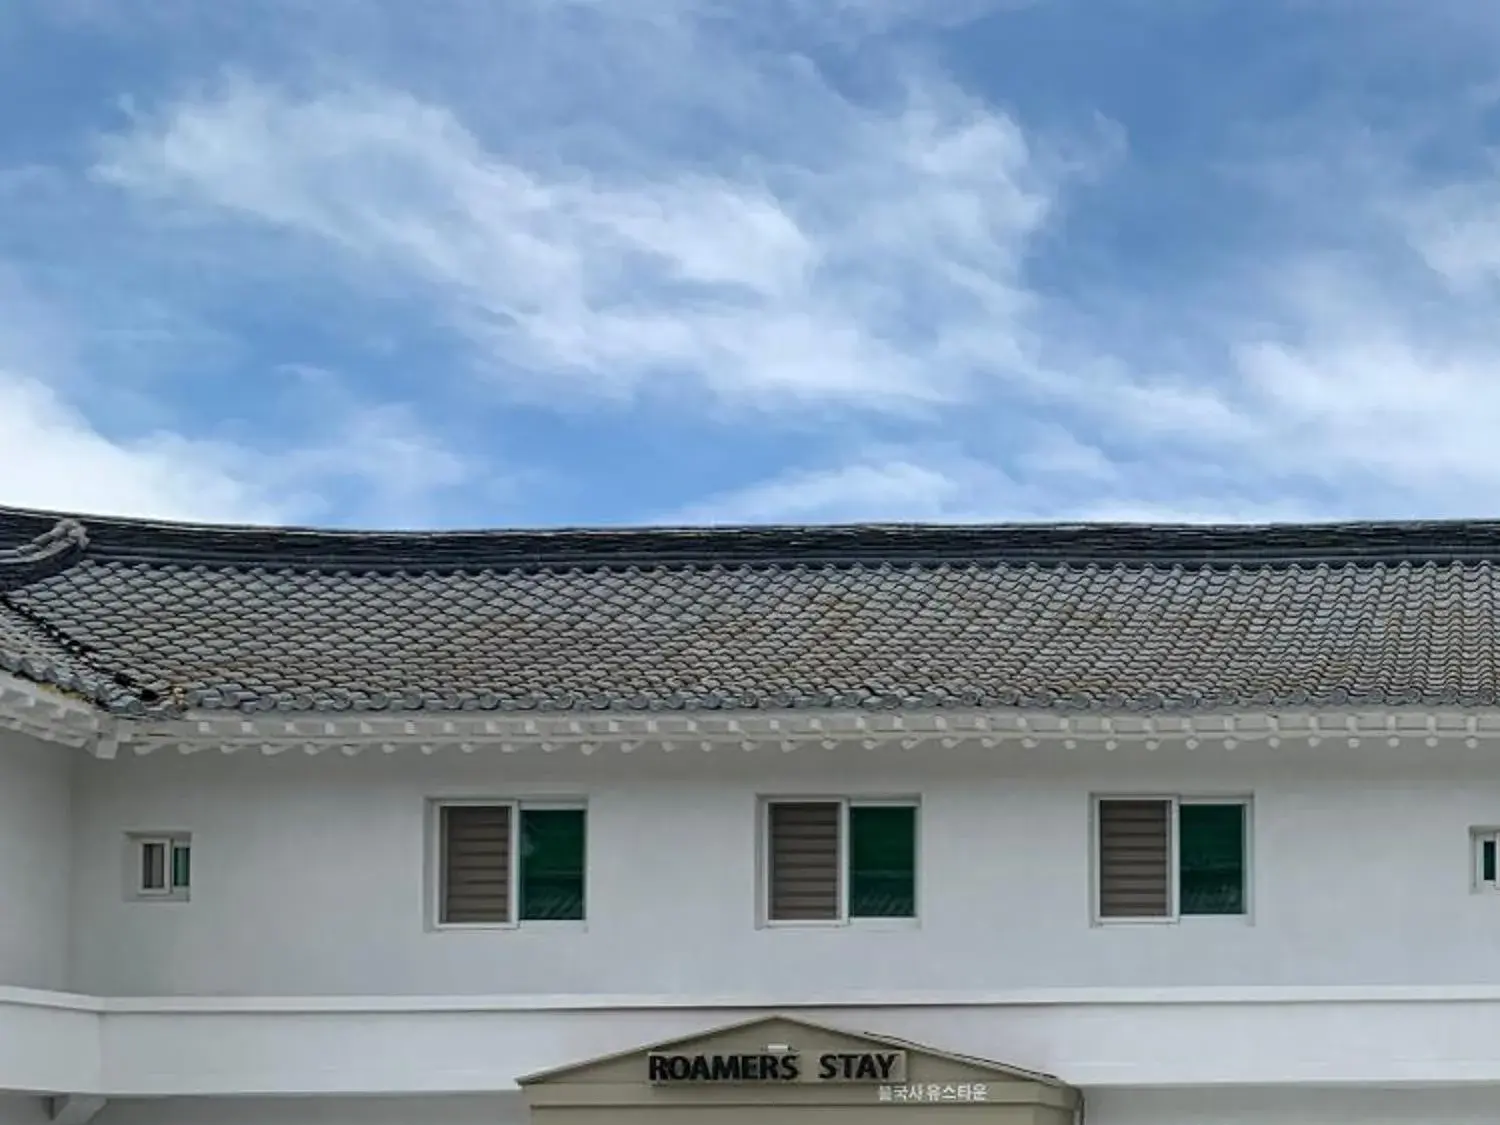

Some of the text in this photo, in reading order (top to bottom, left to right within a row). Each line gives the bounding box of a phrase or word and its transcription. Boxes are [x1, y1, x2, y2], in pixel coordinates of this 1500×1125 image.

[649, 1053, 896, 1081] ROAMERS STAY
[927, 1083, 988, 1101] 유스타운
